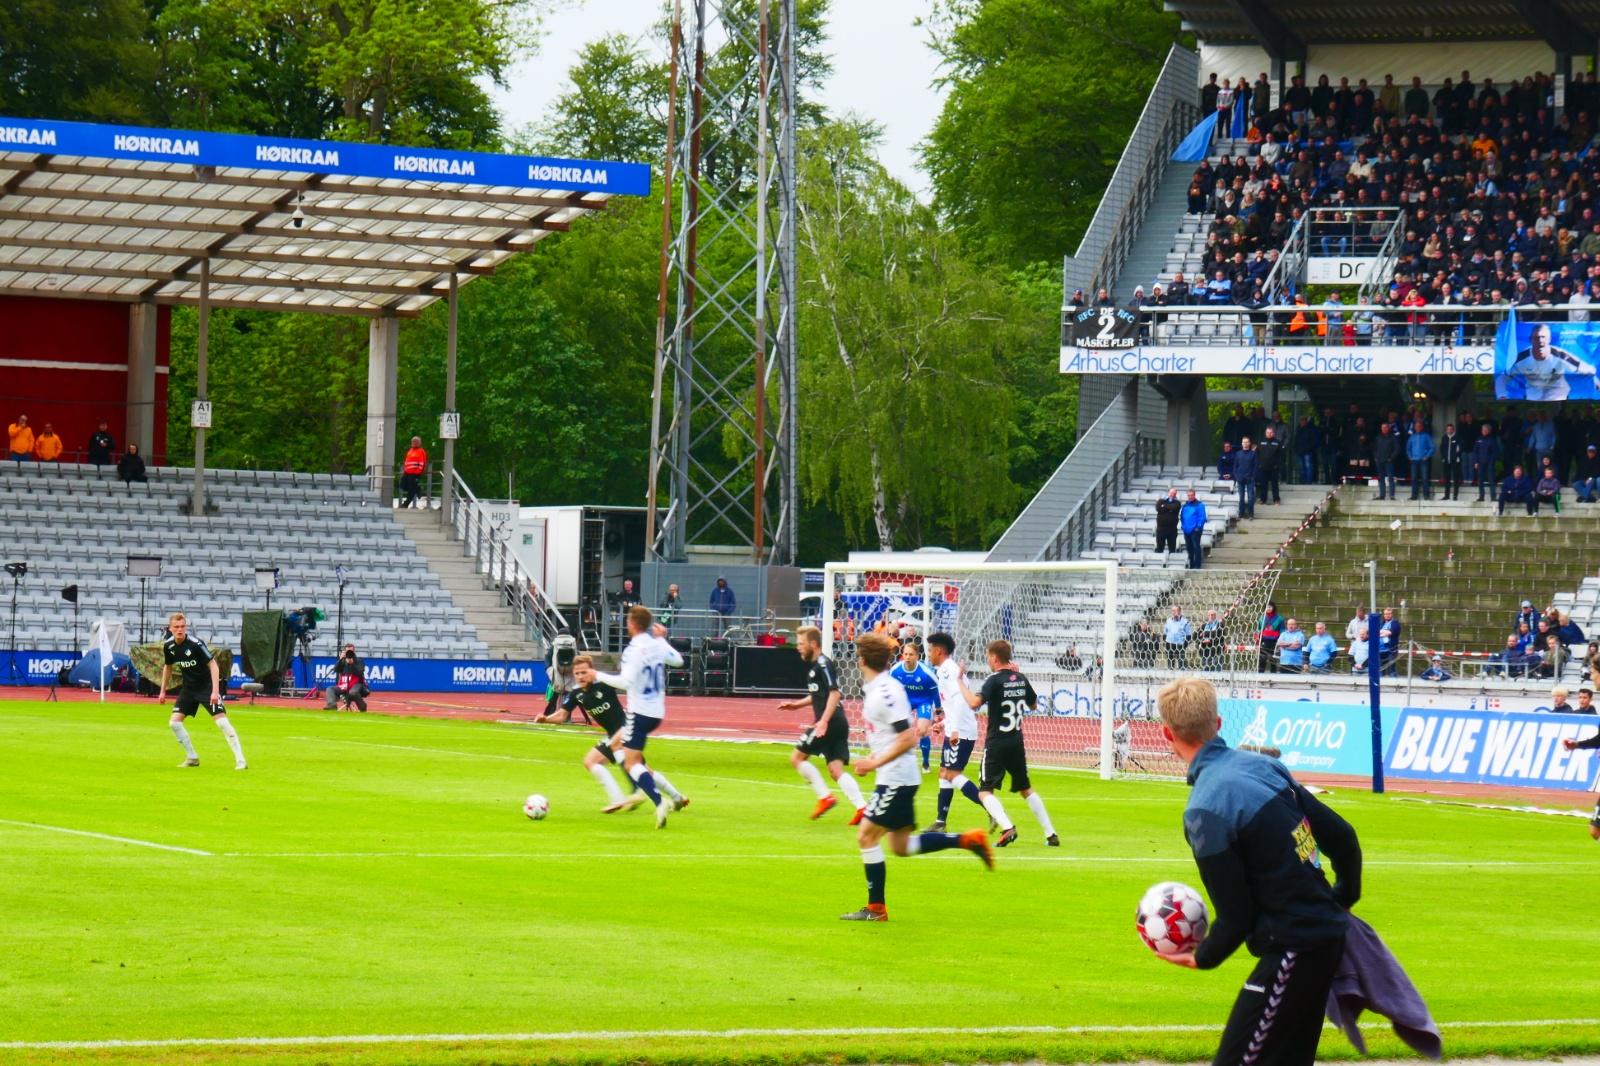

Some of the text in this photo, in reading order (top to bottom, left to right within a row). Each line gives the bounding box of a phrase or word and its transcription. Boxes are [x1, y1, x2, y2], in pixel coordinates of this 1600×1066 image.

[0, 126, 56, 146] RKRAM
[114, 135, 200, 156] HØRKRAM
[256, 146, 339, 166] HØRKRAM
[394, 156, 476, 176] HØRKRAM
[528, 165, 608, 185] HØRKRAM
[1077, 307, 1135, 324] RFC DE RFC
[1096, 315, 1116, 341] 2
[1076, 336, 1135, 347] MÅSKE FLER
[1066, 348, 1196, 372] ÅrhusCharter
[1241, 347, 1374, 372] ÅrhusCharter
[1420, 347, 1493, 372] ÅrhusC
[197, 402, 210, 411] A1
[491, 512, 511, 521] HD3
[453, 666, 532, 683] HØRKRAM
[1272, 712, 1346, 748] arriva
[1390, 715, 1599, 782] BLUE WATER
